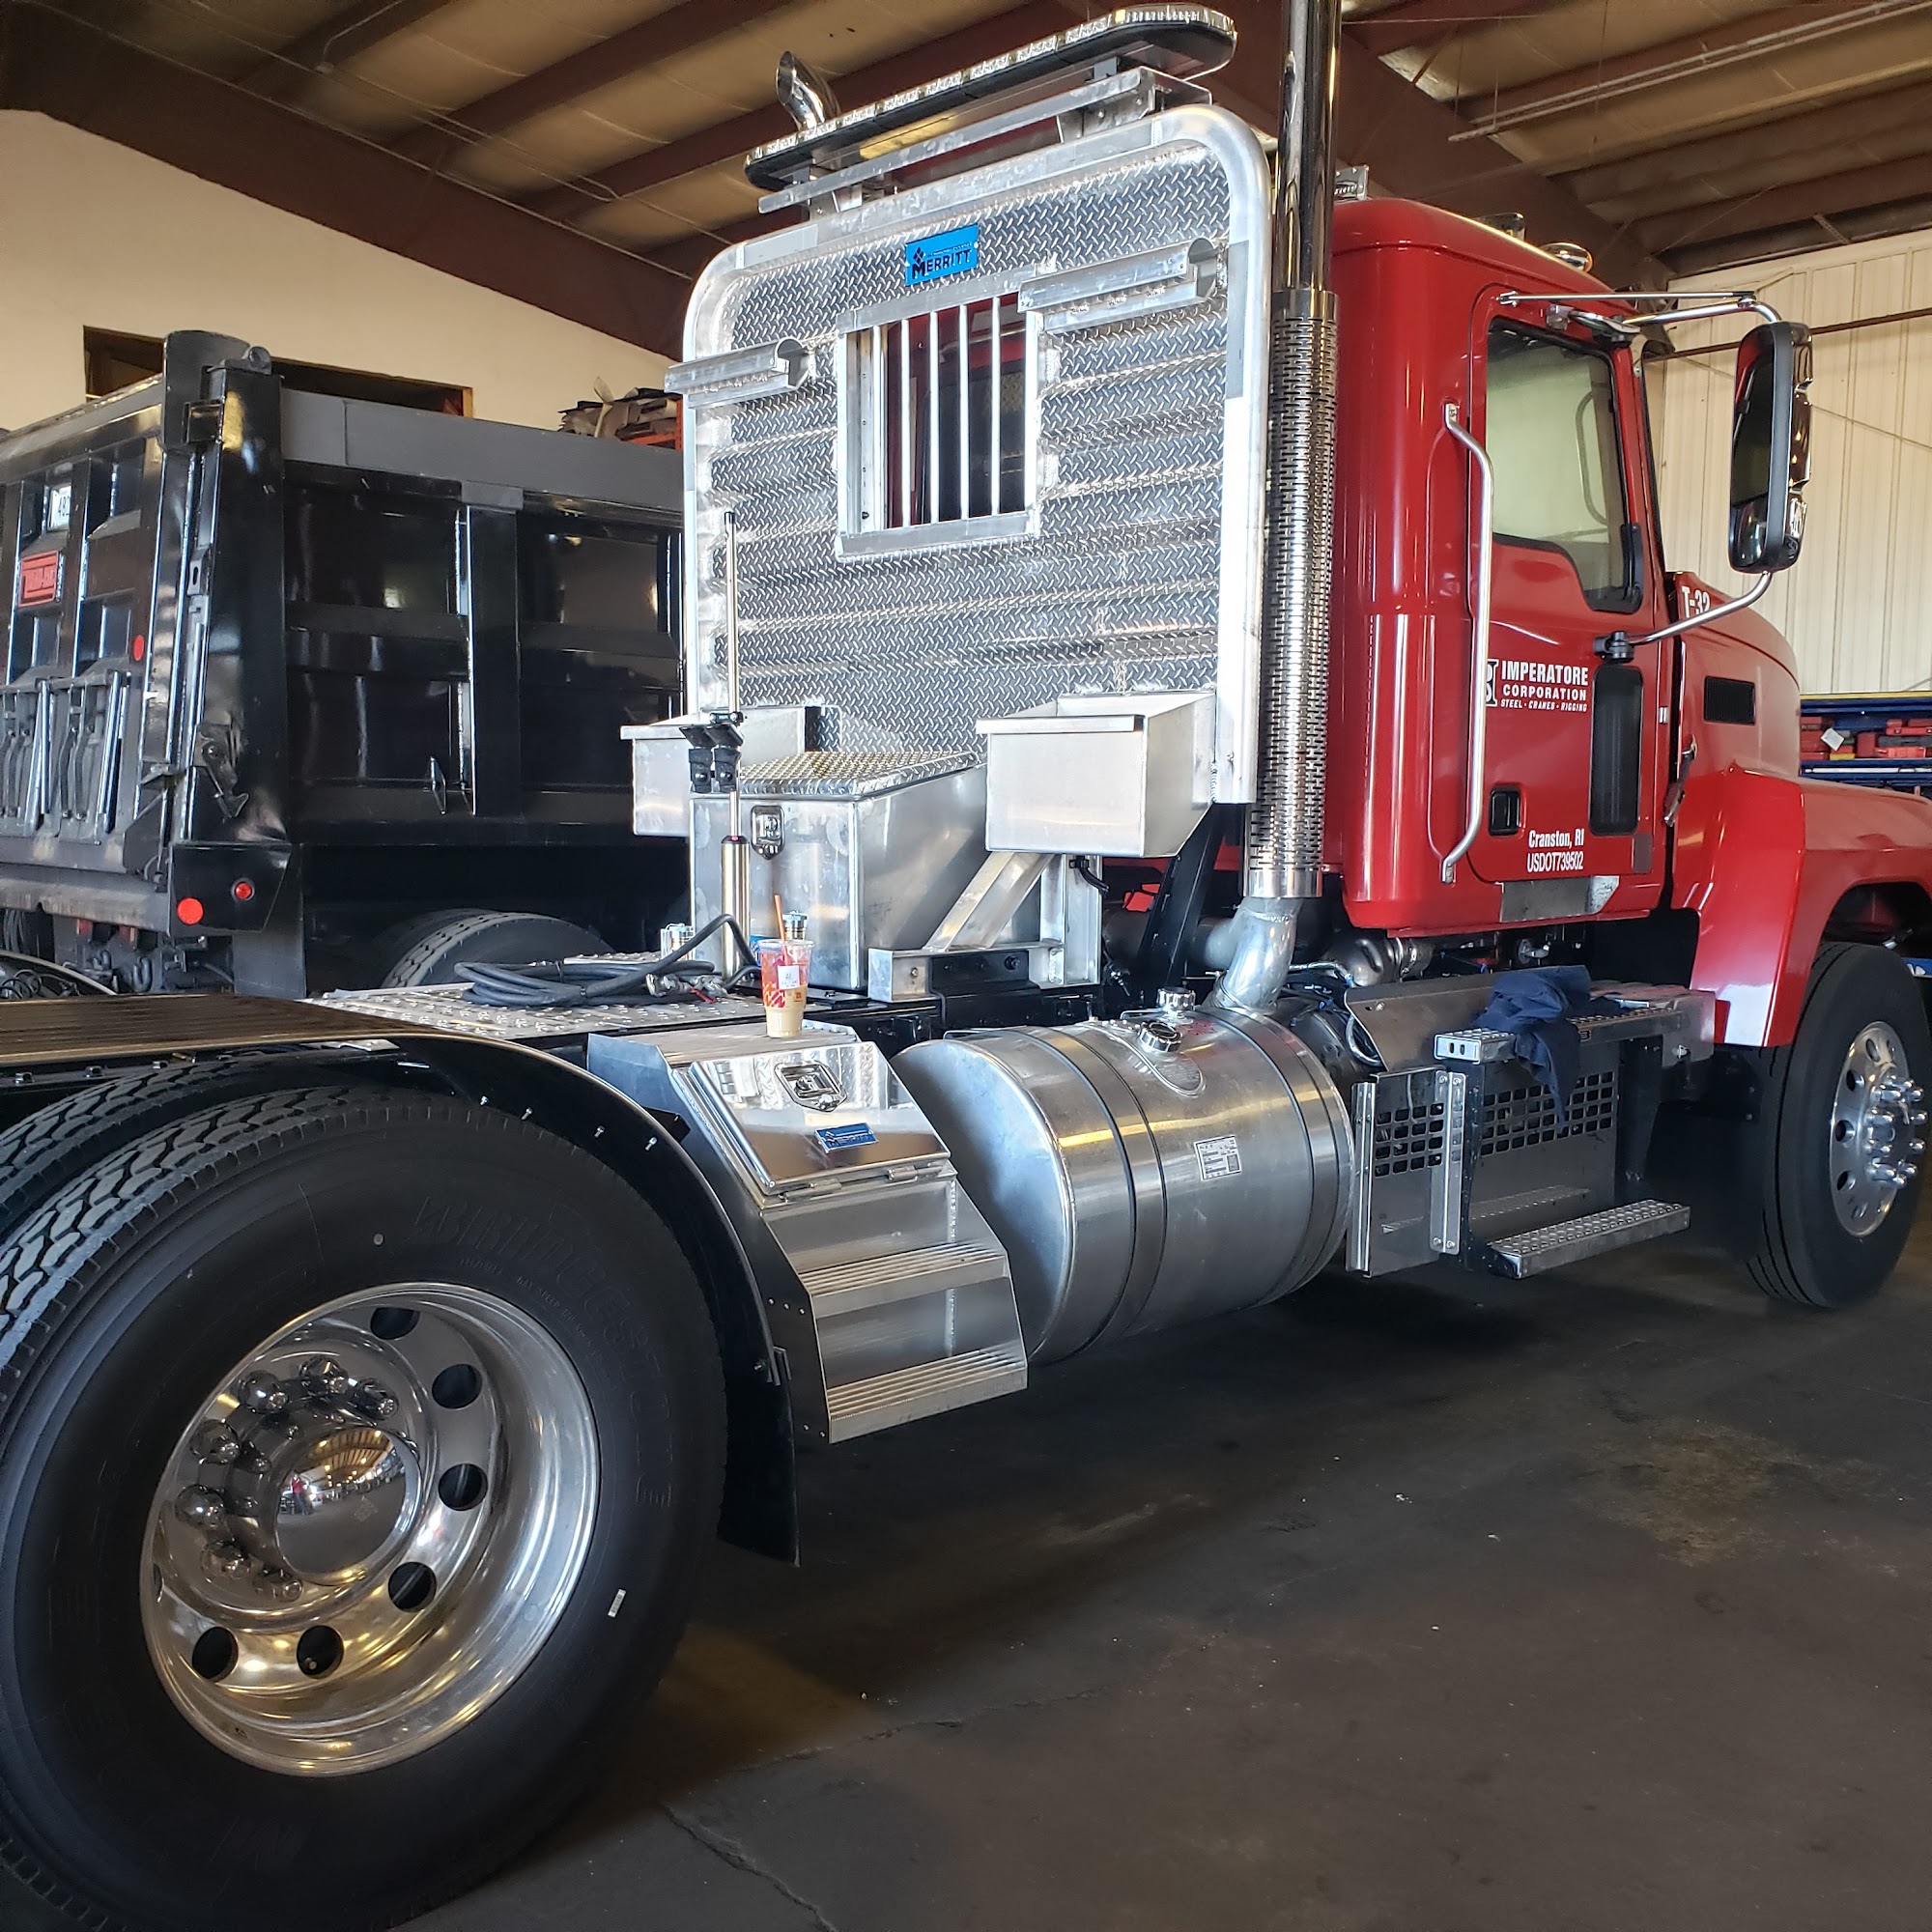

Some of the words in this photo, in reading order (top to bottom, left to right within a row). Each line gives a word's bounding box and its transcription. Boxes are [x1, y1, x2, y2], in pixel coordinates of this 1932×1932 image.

[912, 249, 973, 279] MERRITT
[1681, 585, 1710, 618] T-32
[1501, 660, 1589, 687] IMPERATORE
[1502, 684, 1587, 701] CORPORATION
[1500, 698, 1523, 709] STEEL
[1528, 700, 1555, 710] CRANES
[1560, 702, 1588, 713] RIGGING
[1528, 830, 1573, 849] Cranston,
[1575, 828, 1584, 846] RI
[1527, 850, 1584, 873] USDOT739502
